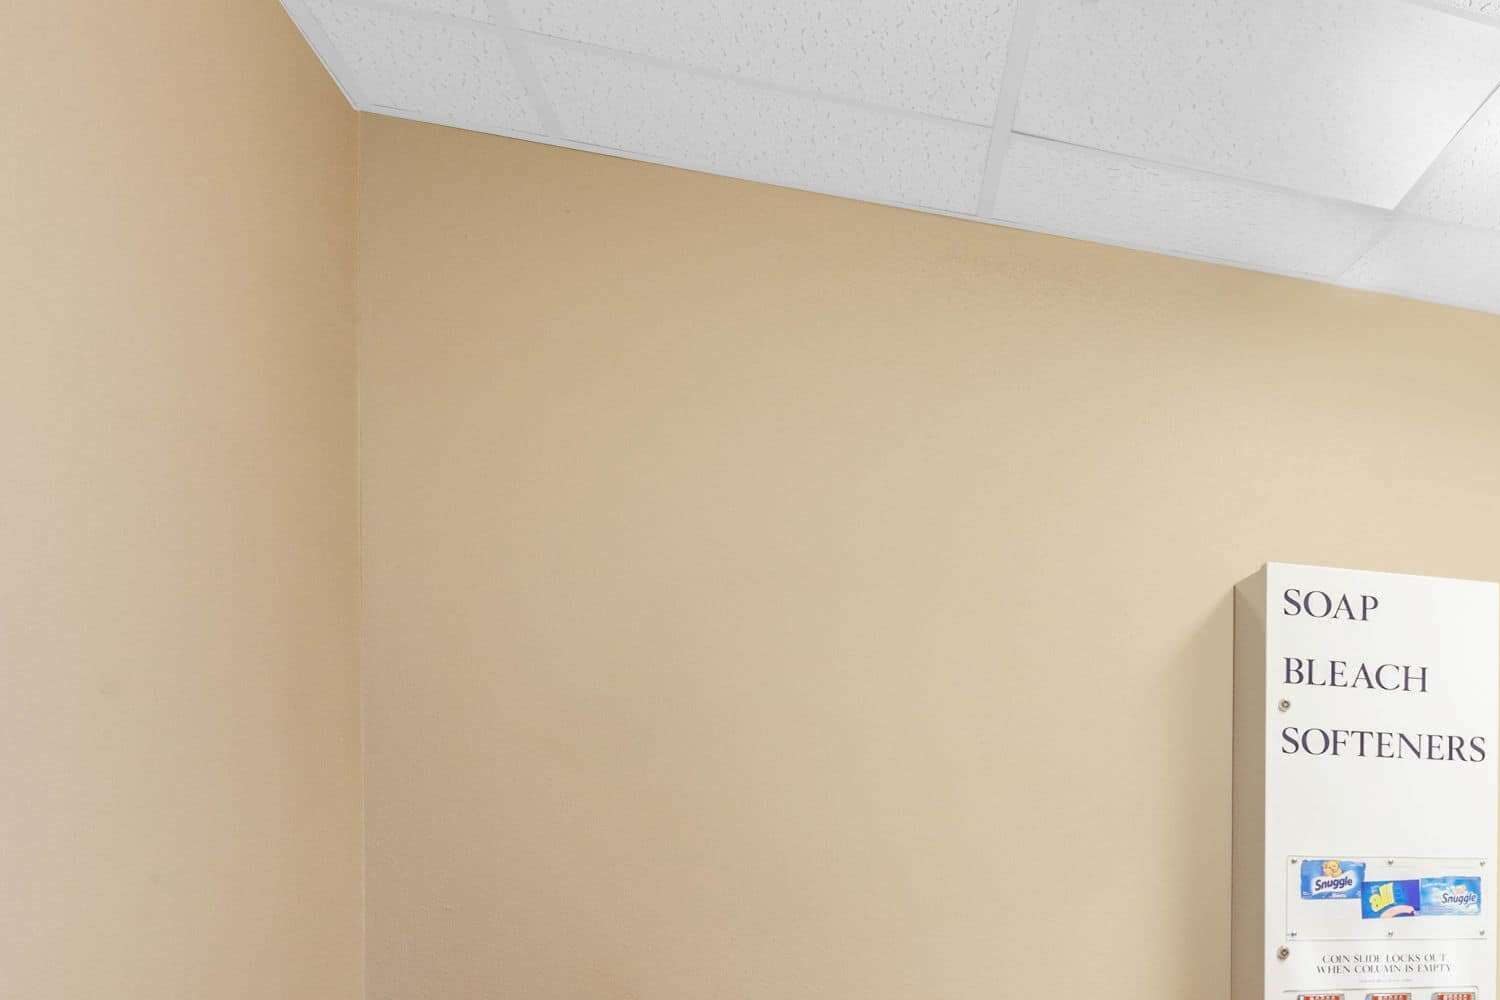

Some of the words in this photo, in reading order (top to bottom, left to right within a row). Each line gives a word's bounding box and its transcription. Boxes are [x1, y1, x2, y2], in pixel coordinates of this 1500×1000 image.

[1283, 588, 1380, 621] SOAP
[1283, 657, 1428, 693] BLEACH
[1281, 727, 1486, 763] SOFTENERS
[1314, 876, 1353, 892] Snuggle
[1441, 893, 1477, 906] Snuggle
[1322, 954, 1350, 964] COIN
[1353, 954, 1380, 963] SLIDE
[1386, 953, 1421, 963] LOCKS
[1424, 952, 1447, 962] OUT
[1316, 965, 1351, 974] WHEN
[1354, 964, 1401, 974] COLUMN
[1405, 964, 1414, 973] IS
[1417, 963, 1451, 973] EMPTY
